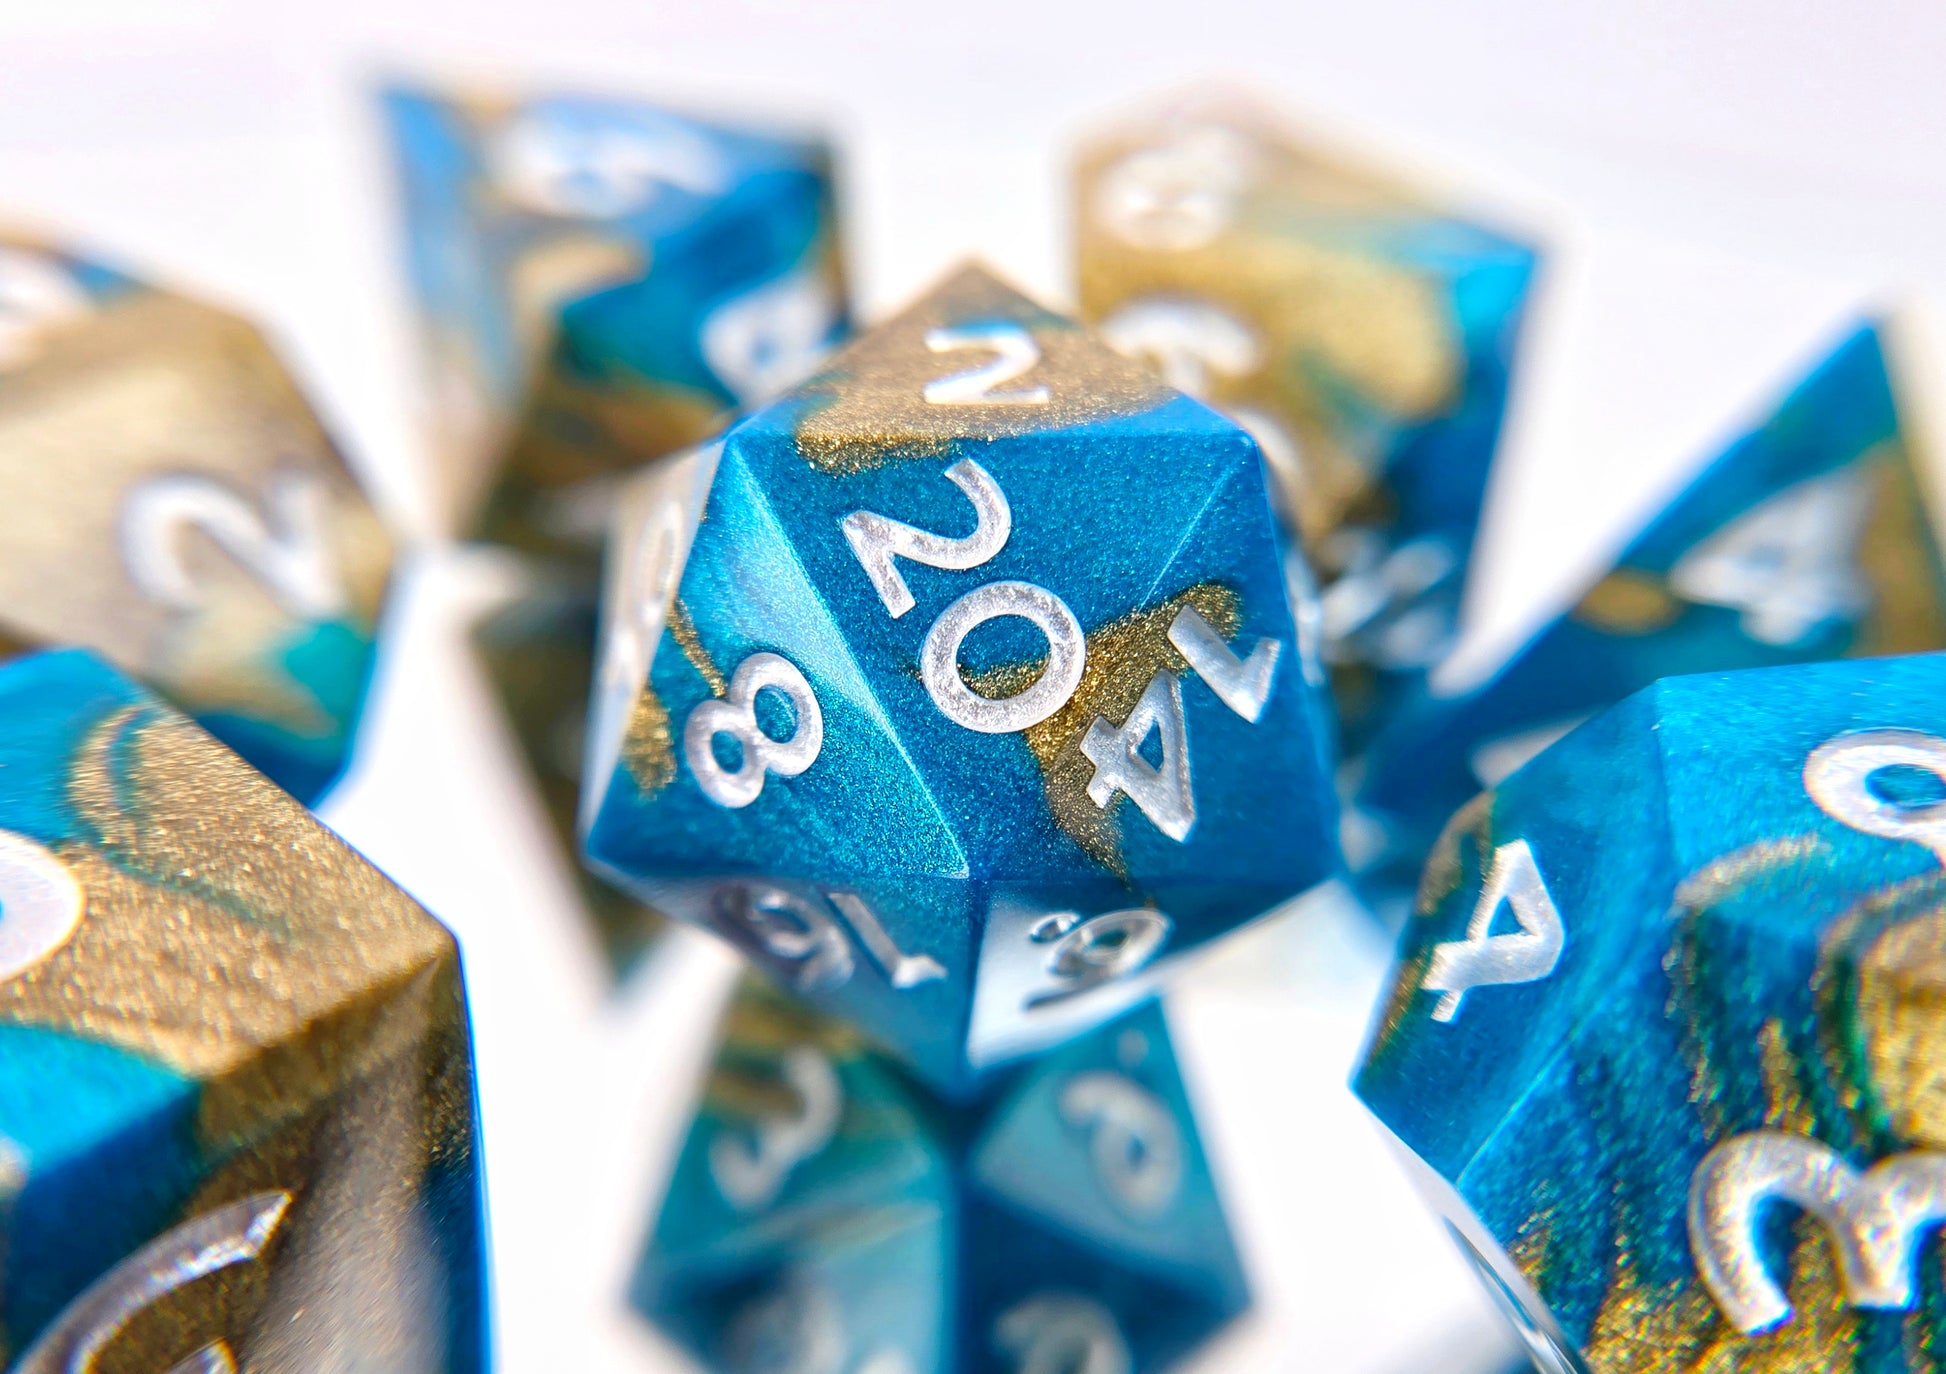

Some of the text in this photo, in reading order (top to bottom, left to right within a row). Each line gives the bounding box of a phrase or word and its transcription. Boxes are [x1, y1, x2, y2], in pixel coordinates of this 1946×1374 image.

[923, 321, 1051, 404] 2
[842, 457, 1086, 733] 20
[684, 652, 823, 808] 8
[1080, 604, 1282, 844] 14
[1420, 838, 1566, 1024] 4
